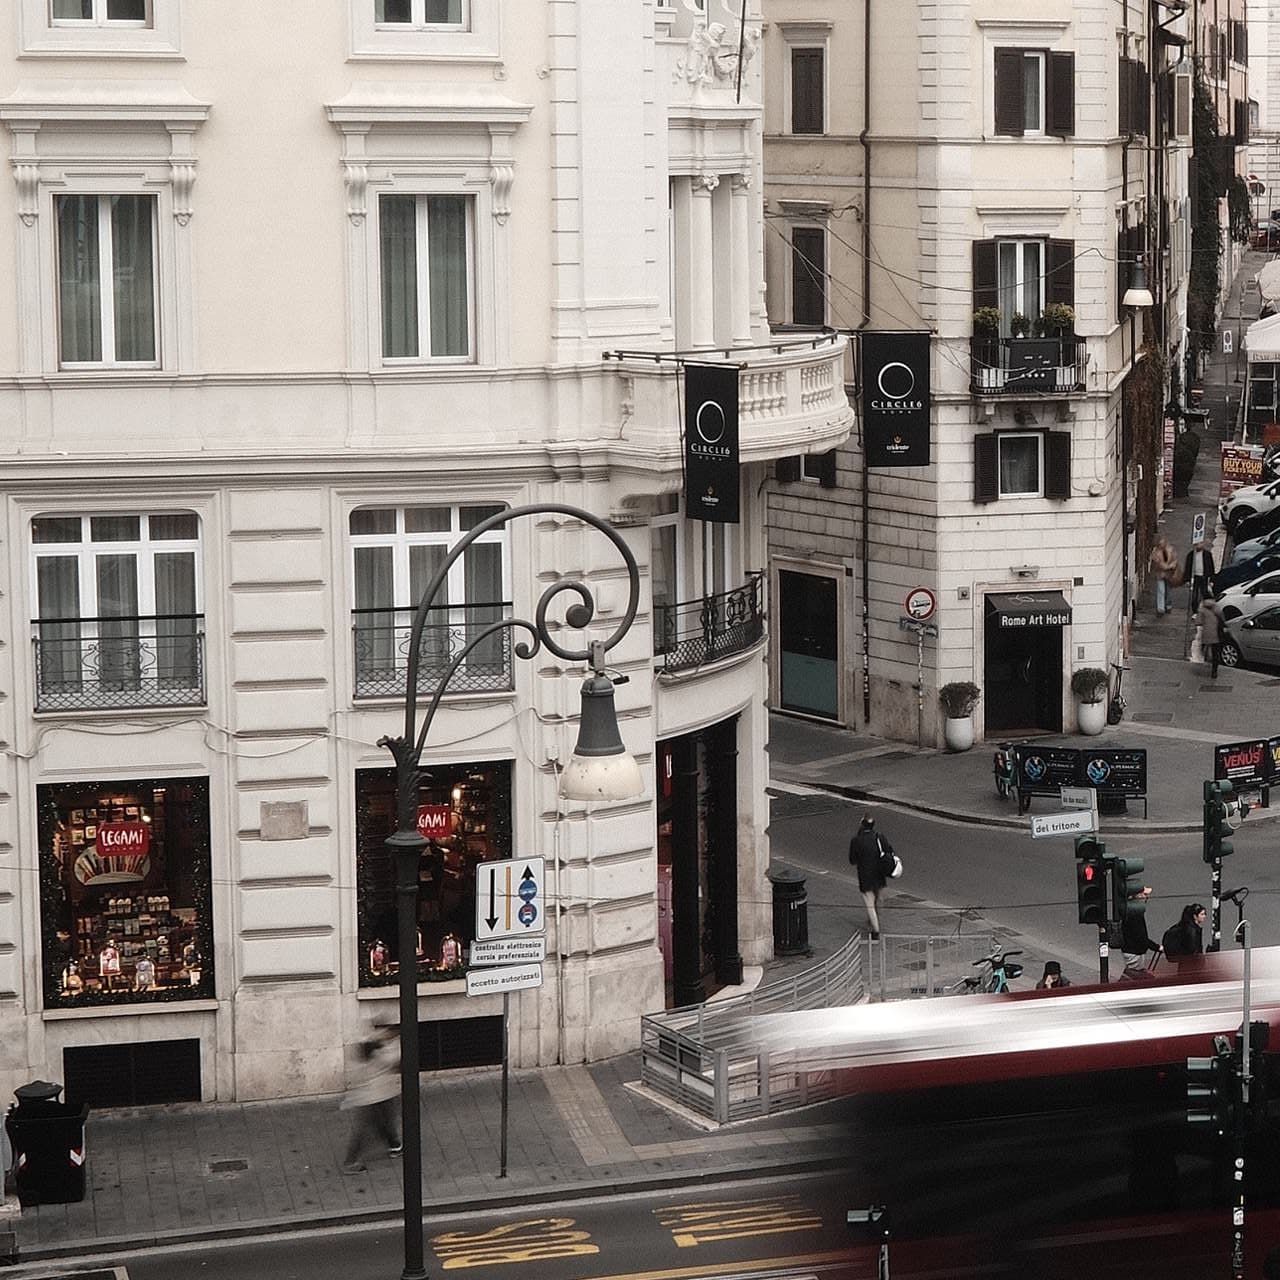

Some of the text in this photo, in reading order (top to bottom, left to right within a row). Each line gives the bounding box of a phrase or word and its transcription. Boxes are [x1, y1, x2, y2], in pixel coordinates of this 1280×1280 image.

[1001, 612, 1070, 627] Rome Art Hotel
[1223, 752, 1261, 768] VENUS
[1035, 821, 1081, 834] del tritone
[475, 942, 541, 951] controllo elettronico
[498, 951, 540, 960] preferenziale
[471, 972, 540, 987] eccetto autorizzati
